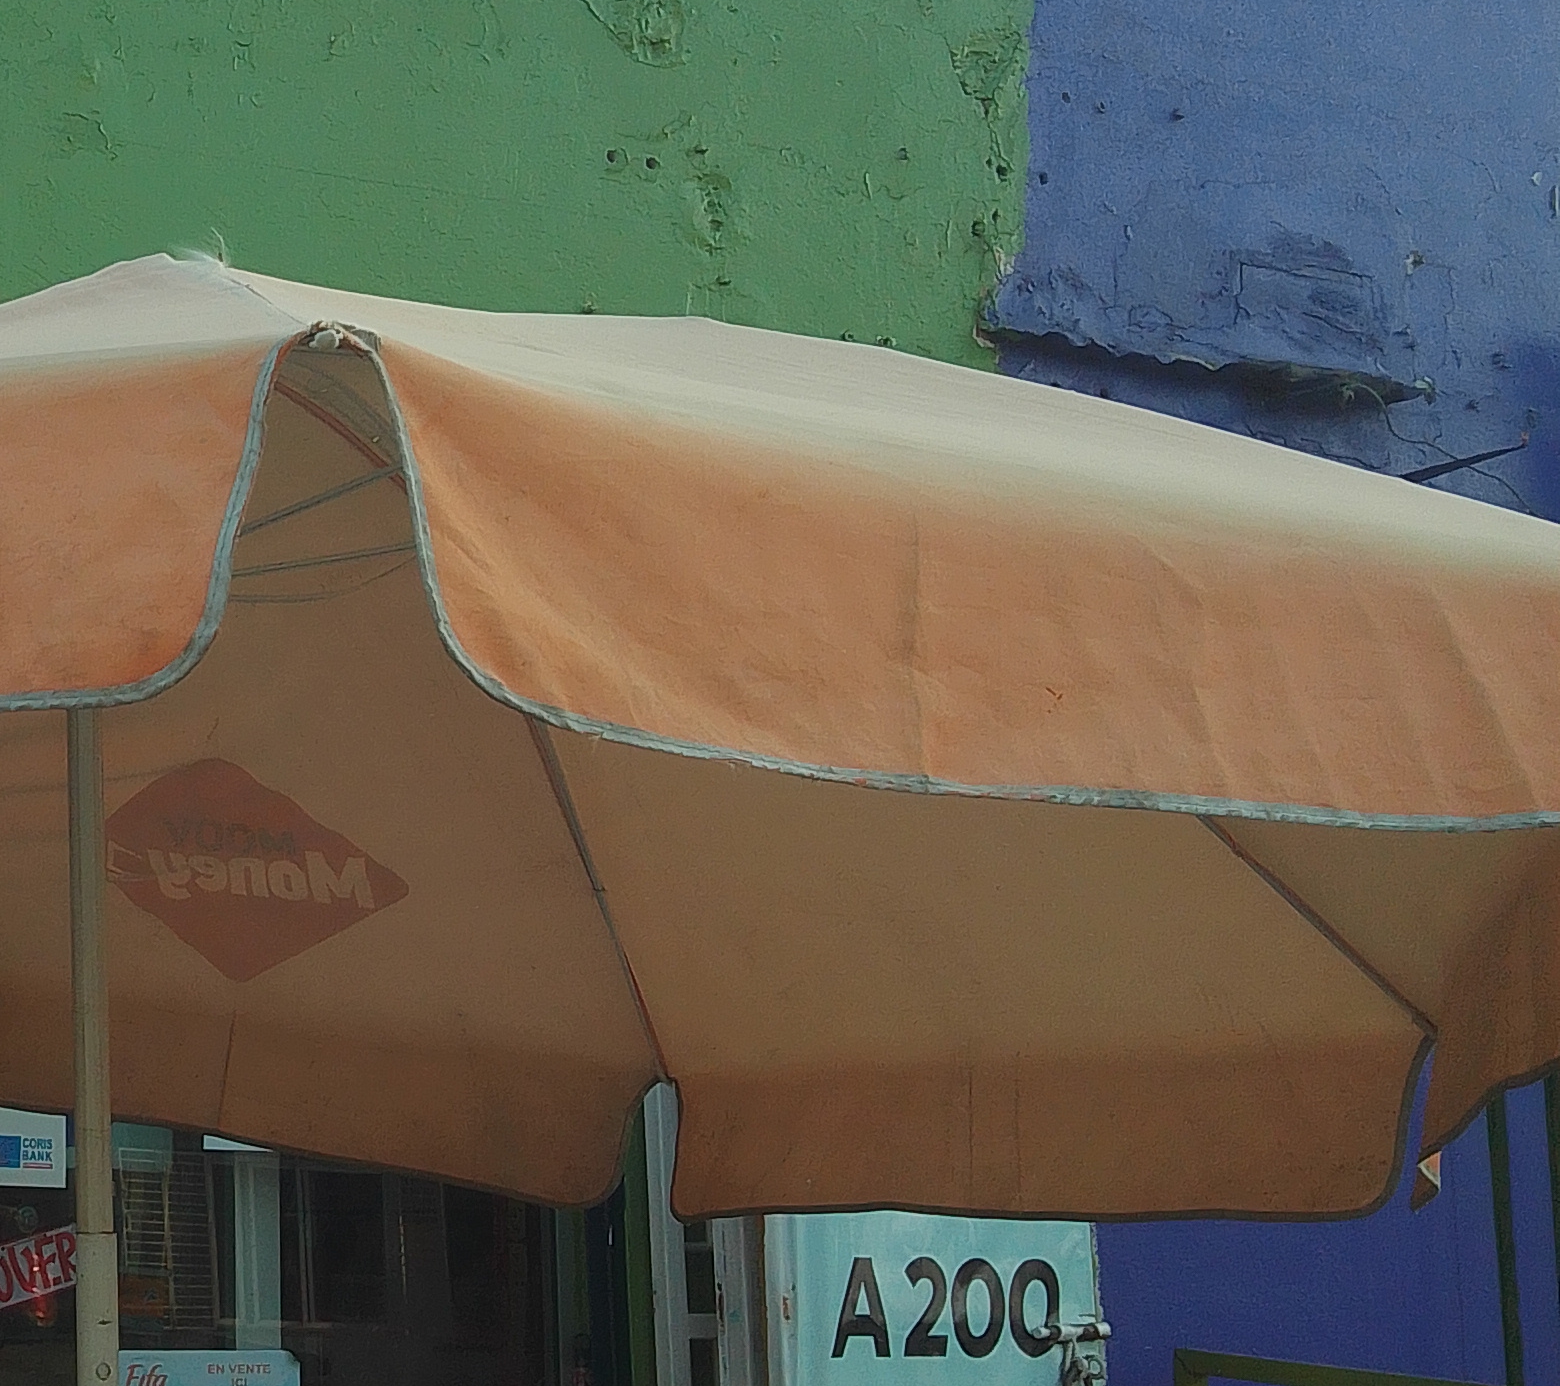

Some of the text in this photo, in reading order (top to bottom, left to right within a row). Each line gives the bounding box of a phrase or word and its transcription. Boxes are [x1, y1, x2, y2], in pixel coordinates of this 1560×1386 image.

[22, 1138, 53, 1150] CORIS
[22, 1150, 53, 1162] BANK
[207, 1363, 271, 1375] EN VENTE
